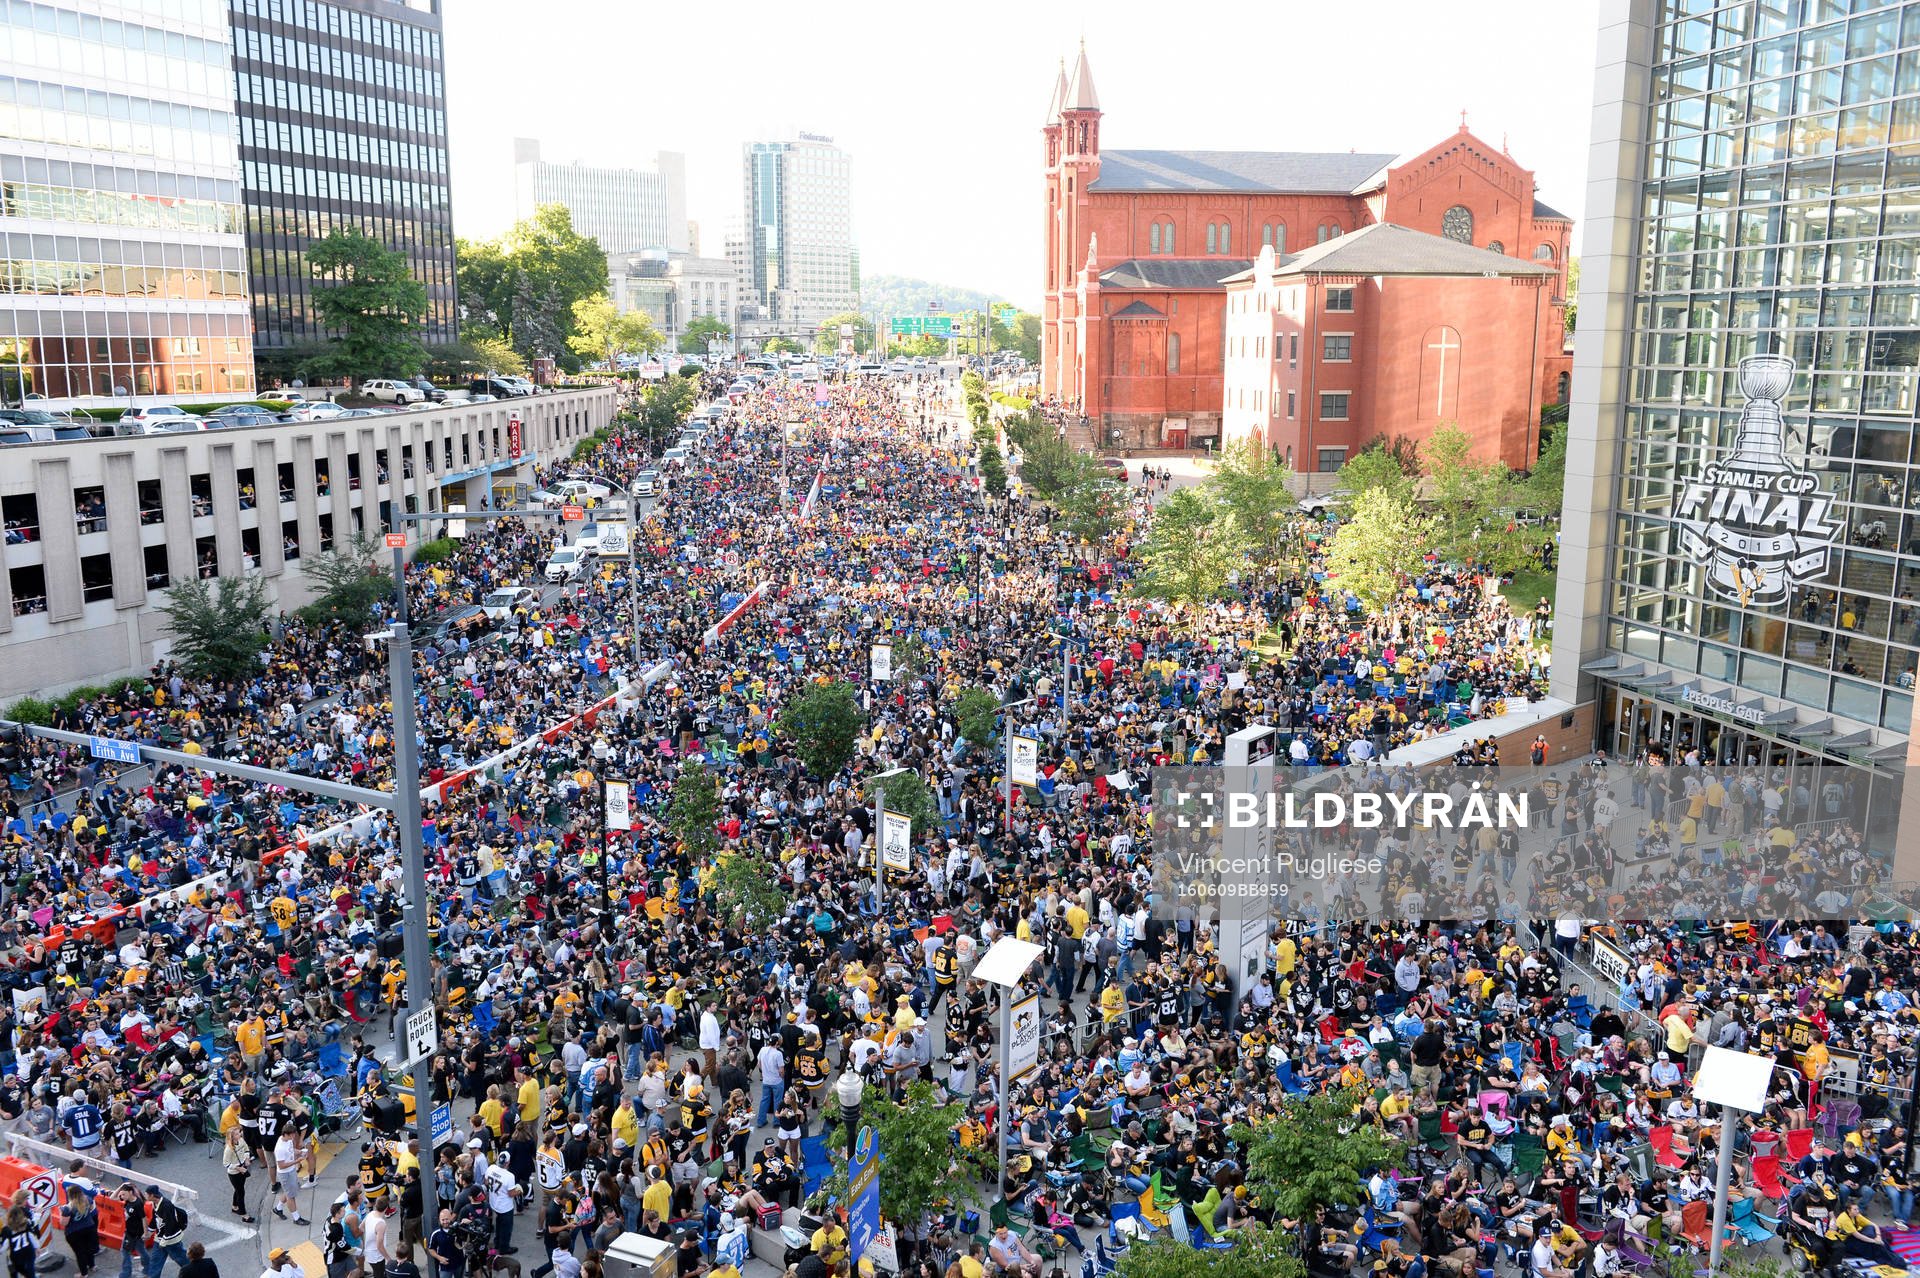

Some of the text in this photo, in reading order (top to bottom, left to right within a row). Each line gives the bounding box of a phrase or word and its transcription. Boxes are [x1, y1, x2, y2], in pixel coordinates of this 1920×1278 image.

[511, 422, 519, 451] PARK
[1705, 467, 1814, 493] STANLEY CUP
[1680, 484, 1835, 536] FINAL
[1720, 532, 1781, 552] 2016
[1689, 690, 1735, 714] PEOPLES
[1735, 704, 1766, 725] GATE
[95, 746, 135, 761] Fifth Ave
[464, 863, 475, 876] 71
[273, 907, 287, 920] 58
[61, 950, 78, 964] 87
[1598, 948, 1623, 971] LET'S GO
[1161, 1000, 1177, 1015] 87
[408, 1009, 433, 1029] TRUCK
[409, 1021, 434, 1042] ROUTE
[1011, 1024, 1038, 1049] PLAYOFF
[1792, 1029, 1809, 1046] 81
[801, 1061, 817, 1077] 66
[51, 1084, 60, 1093] 9
[260, 1110, 275, 1118] CROSBY
[432, 1108, 447, 1123] Bus
[78, 1118, 91, 1135] 11
[114, 1120, 132, 1130] MAKIN
[258, 1118, 278, 1136] 87
[432, 1118, 450, 1135] Stop
[116, 1130, 135, 1148] 71
[540, 1165, 548, 1183] 5
[851, 1164, 875, 1197] East End
[851, 1194, 870, 1221] Bigelow
[11, 1233, 29, 1251] 71
